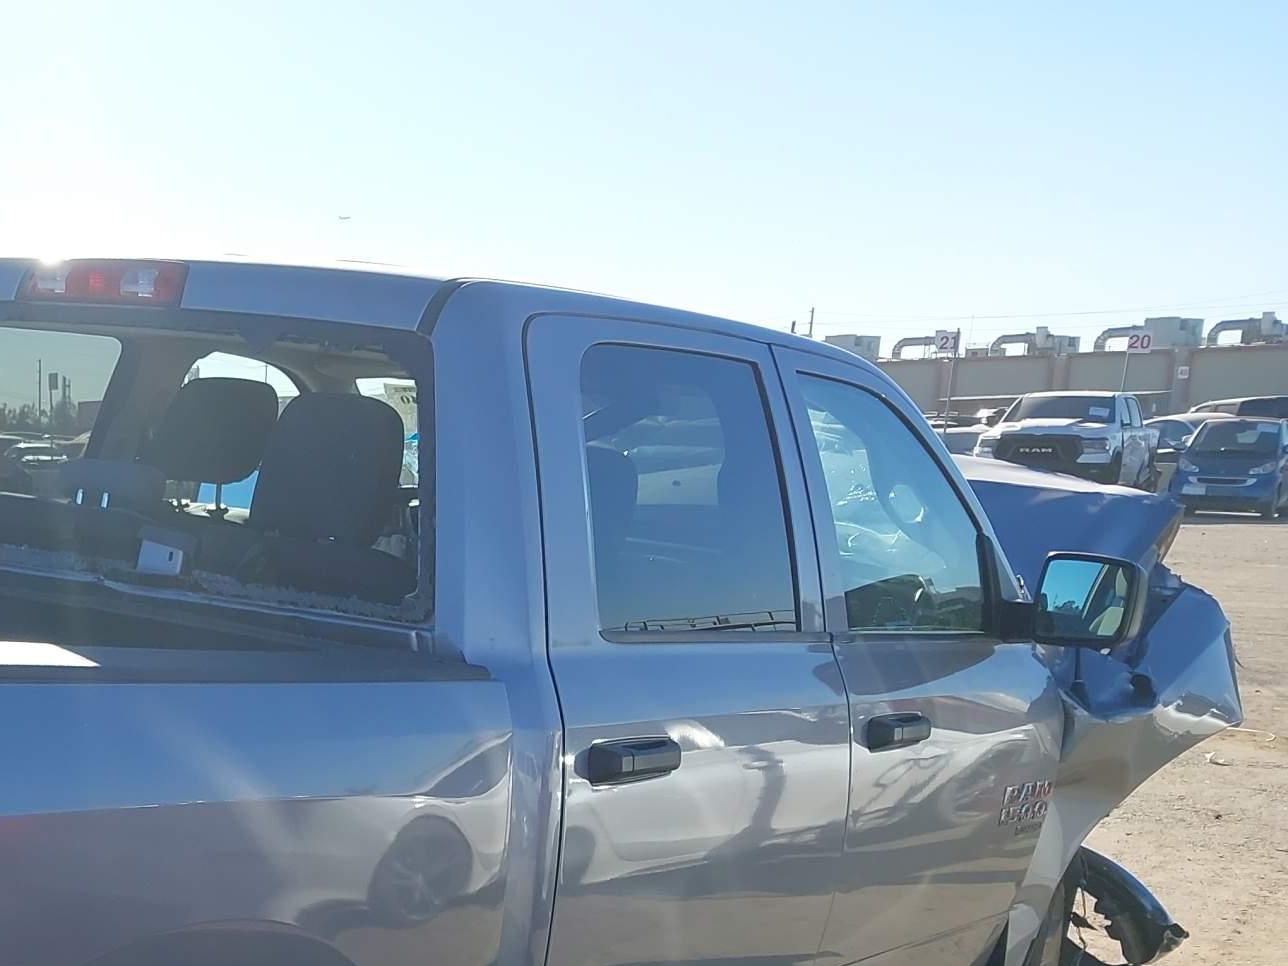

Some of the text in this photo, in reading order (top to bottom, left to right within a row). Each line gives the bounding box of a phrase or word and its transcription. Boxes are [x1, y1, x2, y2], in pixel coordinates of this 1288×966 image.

[939, 335, 958, 350] 21
[1128, 334, 1152, 349] 20
[1018, 447, 1054, 455] RAM
